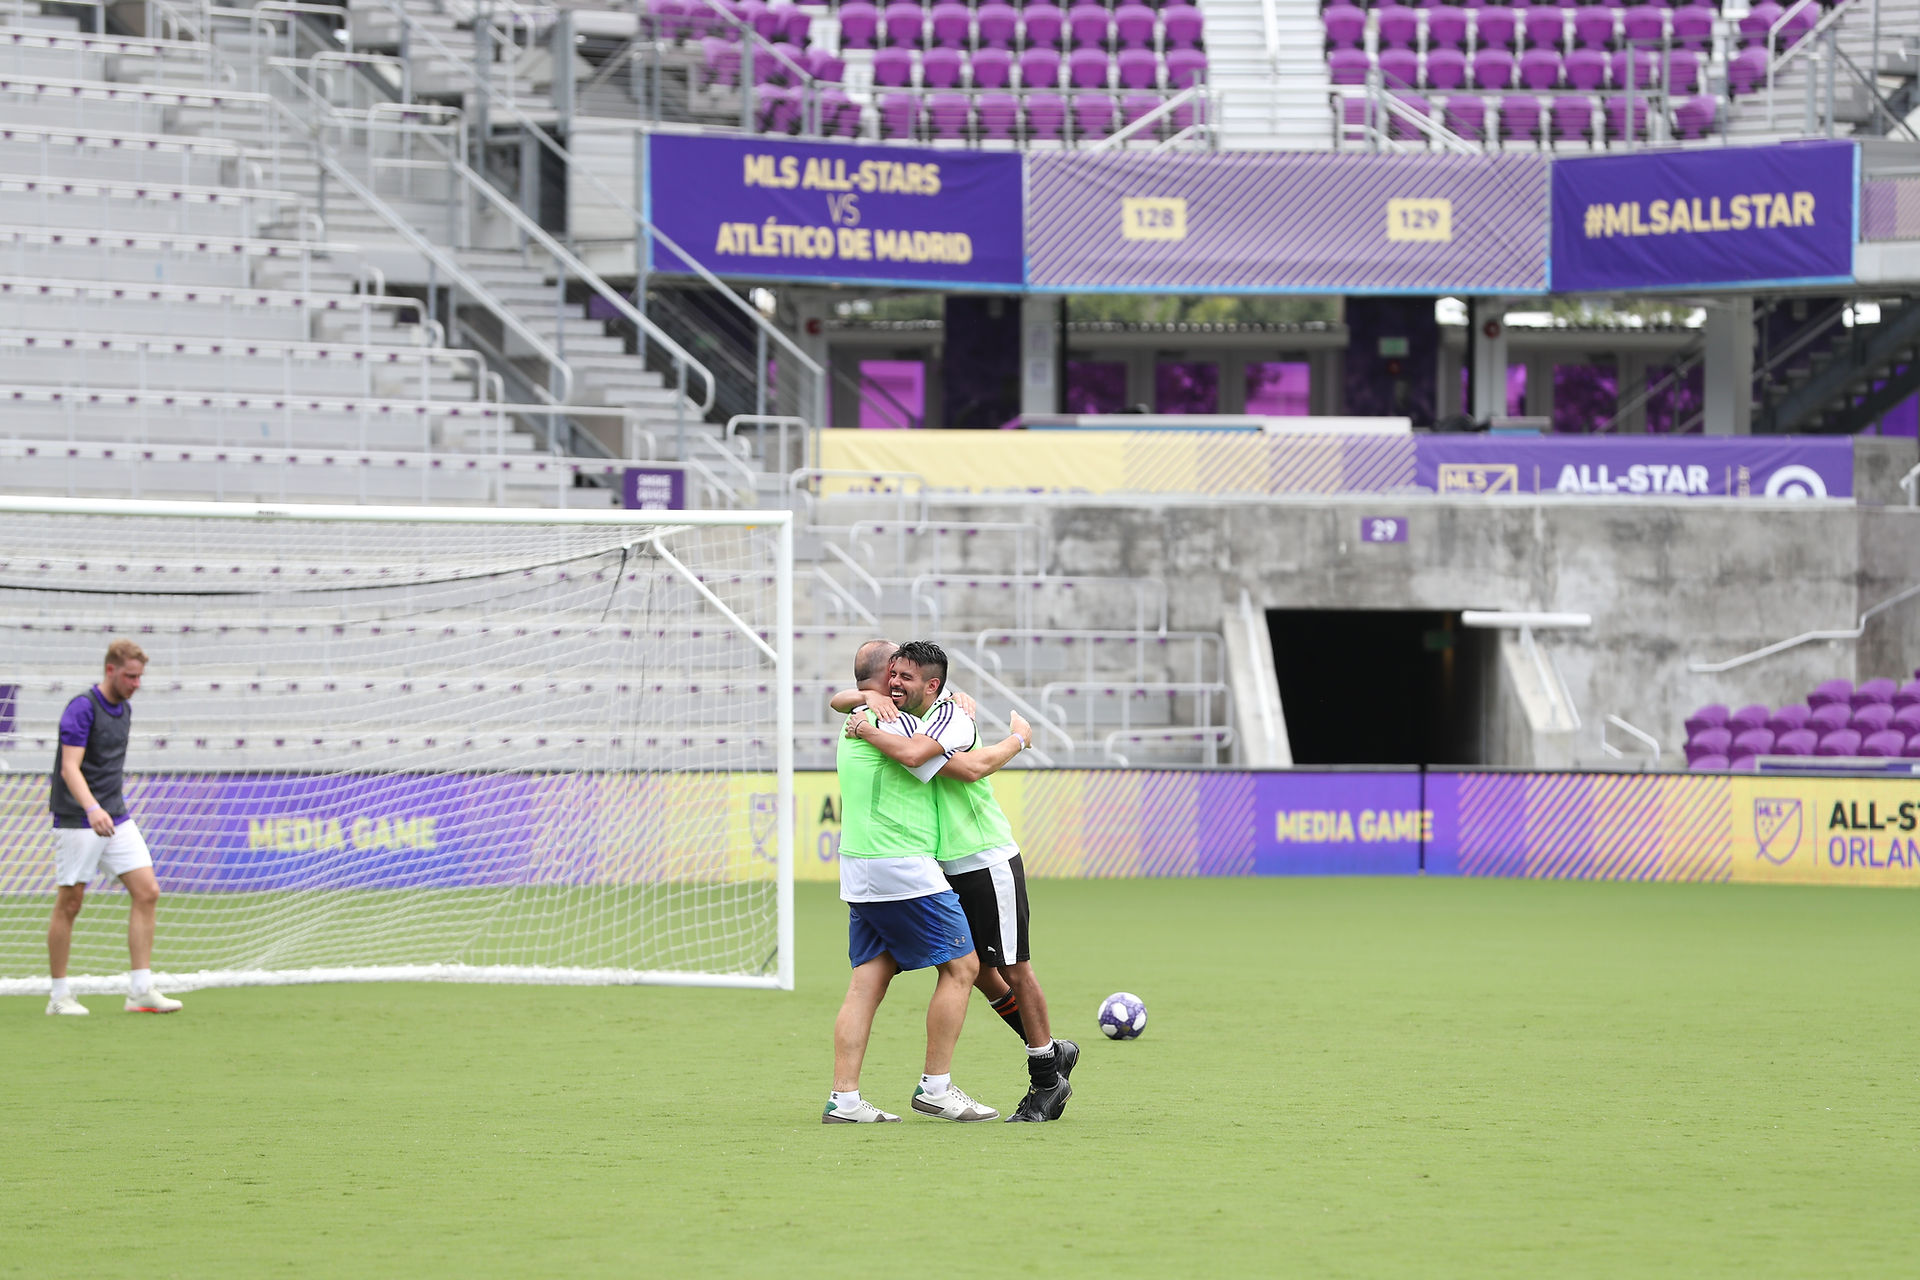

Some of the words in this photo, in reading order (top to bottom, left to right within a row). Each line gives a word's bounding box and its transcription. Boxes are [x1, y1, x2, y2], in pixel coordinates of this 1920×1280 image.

[744, 154, 799, 188] MLS
[802, 158, 942, 196] ALL-STARS
[827, 193, 861, 226] VS
[1135, 206, 1175, 229] 128
[1399, 207, 1441, 230] 129
[1584, 191, 1816, 239] #MLSALLSTAR
[715, 216, 834, 259] ATLÉTICO
[838, 228, 873, 260] DE
[875, 230, 972, 264] MADRID
[1556, 463, 1710, 494] ALL-STAR
[1370, 518, 1398, 541] 29
[1276, 809, 1355, 843] MEDIA
[1359, 809, 1434, 843] GAME
[1829, 800, 1920, 831] ALL-S
[248, 816, 346, 851] MEDIA
[350, 815, 438, 851] GAME
